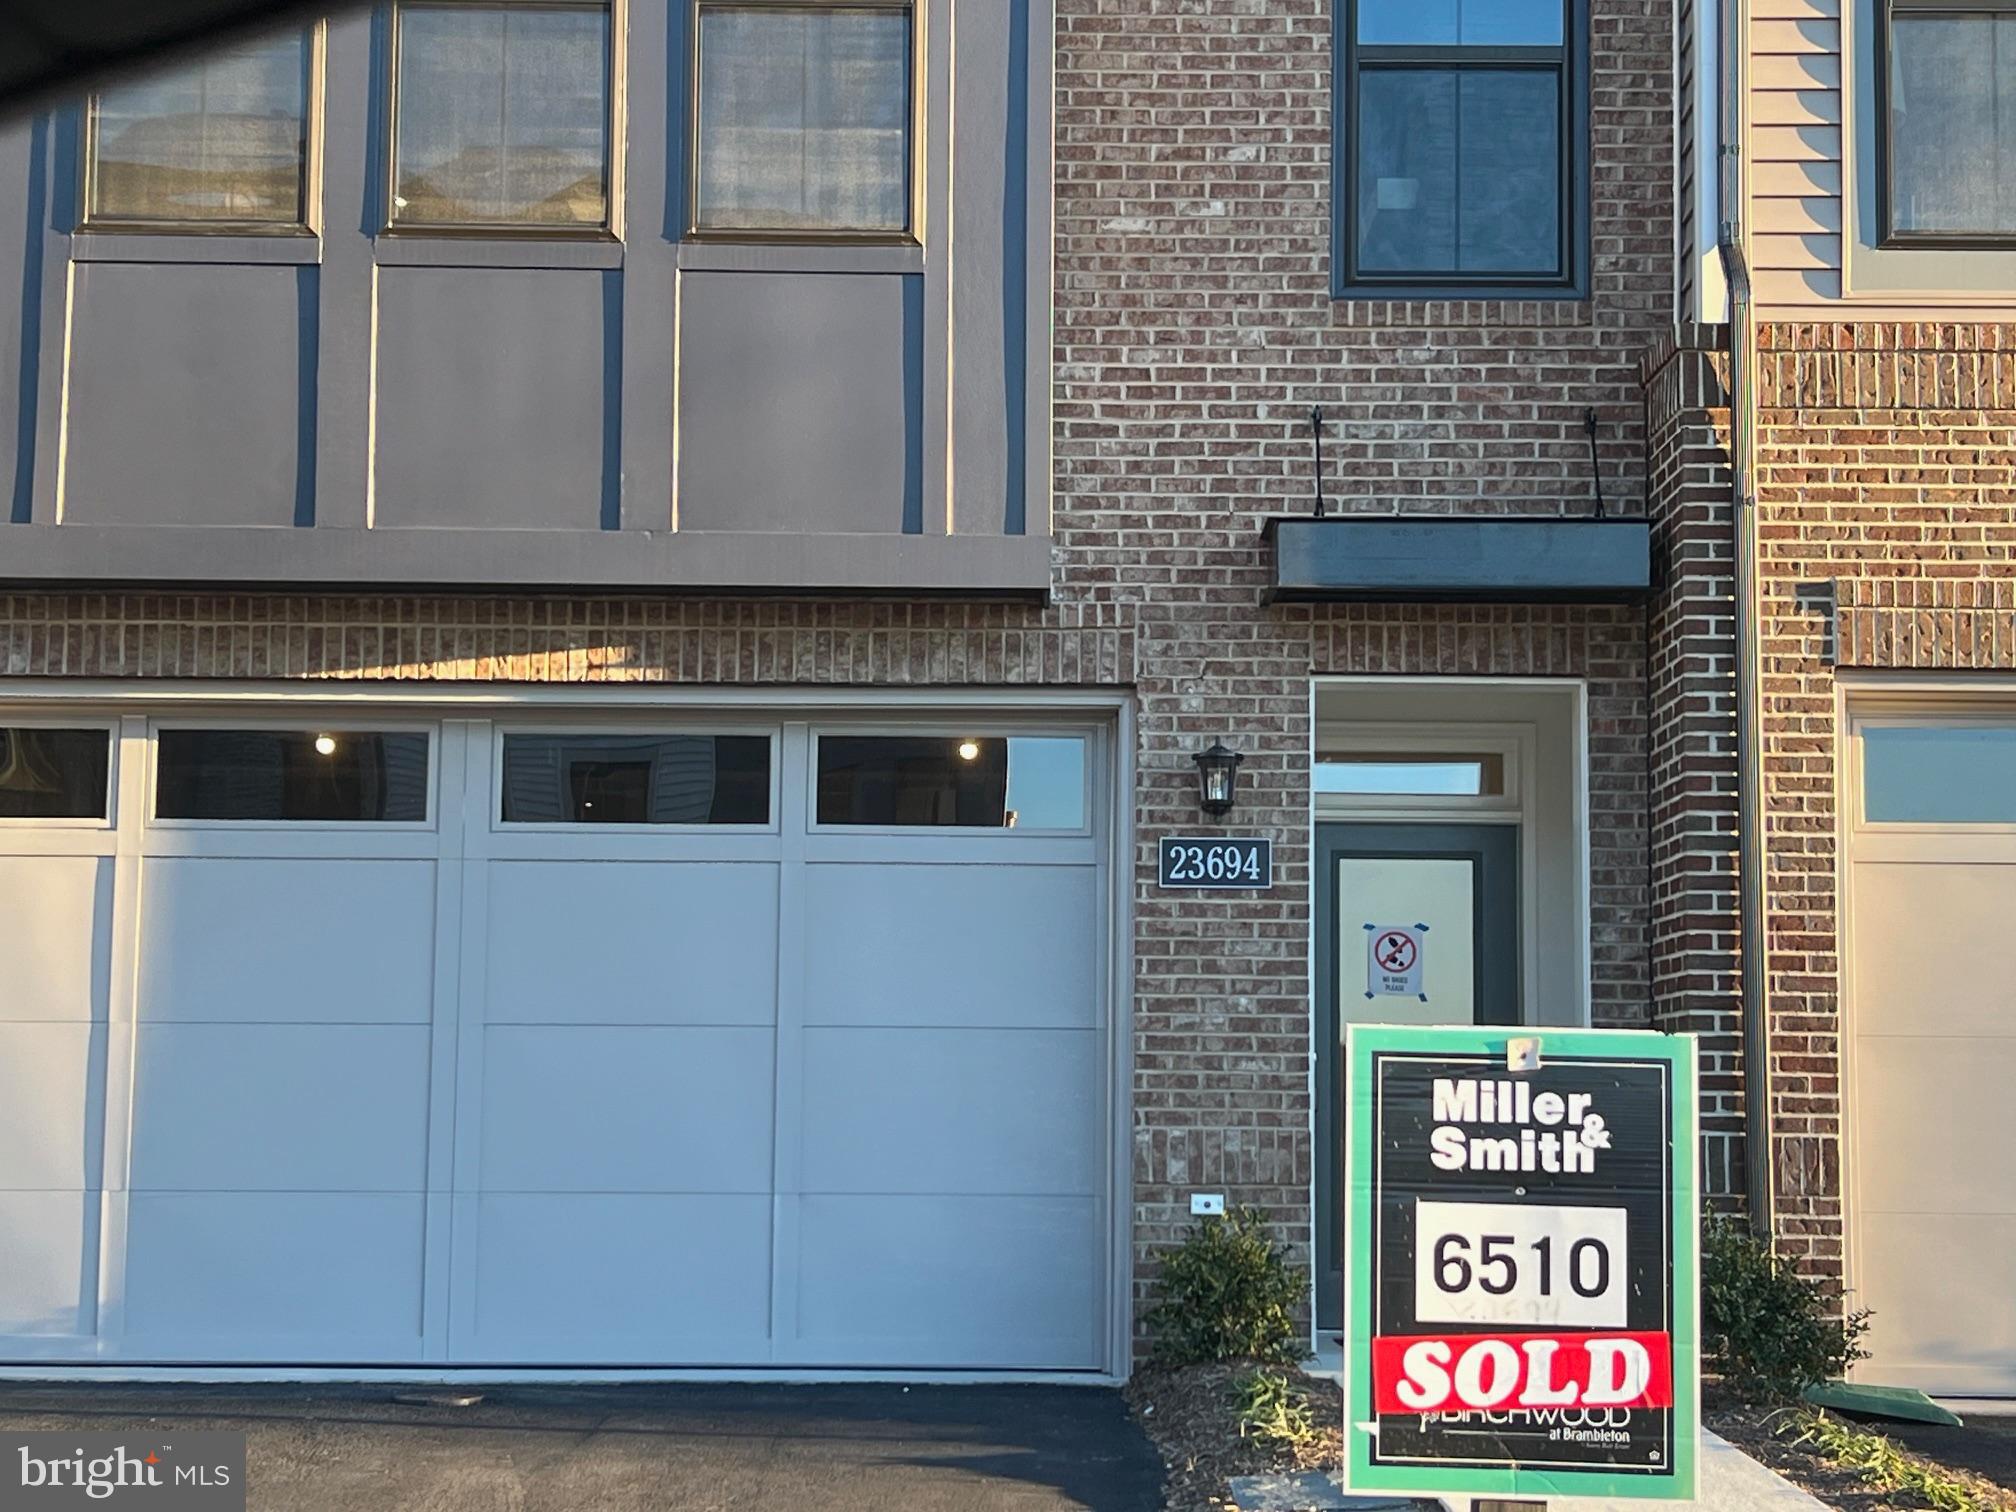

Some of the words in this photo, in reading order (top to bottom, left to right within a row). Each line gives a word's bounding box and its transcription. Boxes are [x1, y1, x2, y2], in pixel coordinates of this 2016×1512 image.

[1168, 846, 1261, 881] 23694
[1432, 1078, 1593, 1126] Miller
[1430, 1125, 1595, 1174] Smith
[1580, 1113, 1612, 1149] &
[1433, 1233, 1610, 1299] 6510
[1396, 1339, 1651, 1407] SOLD
[1549, 1428, 1561, 1440] at
[1563, 1427, 1631, 1443] Brambleton
